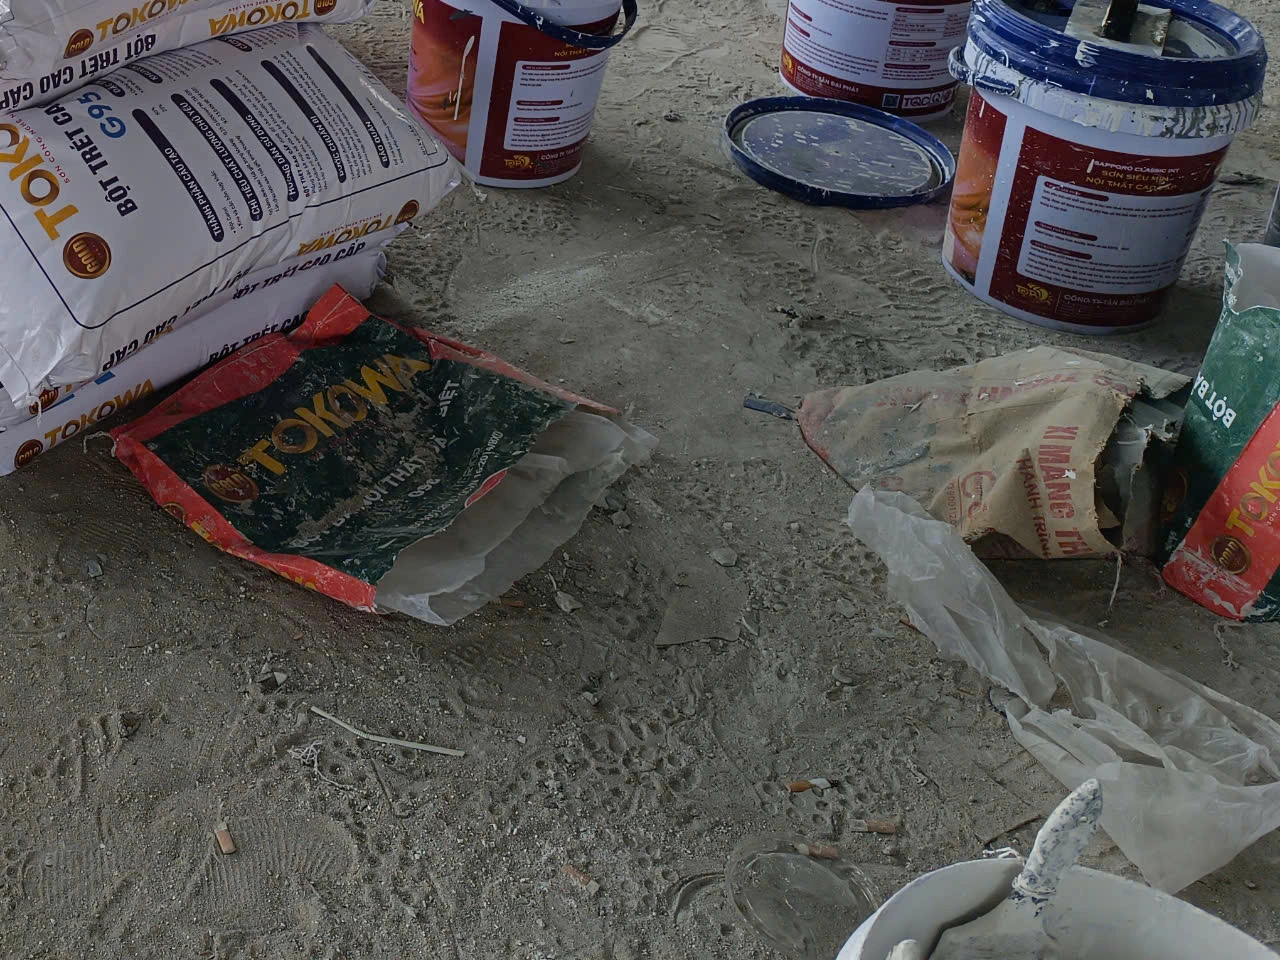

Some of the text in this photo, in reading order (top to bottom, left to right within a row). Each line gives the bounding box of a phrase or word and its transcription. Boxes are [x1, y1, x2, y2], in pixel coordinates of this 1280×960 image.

[124, 33, 156, 60] BỘT
[79, 47, 120, 79] TRÉT
[39, 66, 74, 93] CAO
[76, 91, 126, 139] G95
[246, 113, 265, 136] DỤNG
[260, 134, 272, 148] SỬ
[269, 145, 284, 164] DẪN
[64, 127, 138, 217] BỘT TRÉT
[180, 100, 262, 215] CHỈ TIÊU CHẤT LƯỢNG CHỦ YẾU
[1095, 160, 1133, 171] SAPPORO
[164, 146, 224, 235] THÀNH PHẦN CẤU TẠO
[1086, 177, 1134, 189] NỘI THẤT
[1102, 170, 1124, 179] SƠN
[297, 214, 393, 257] TOKOWA
[332, 239, 366, 262] CẤP
[73, 240, 101, 273] GOLD
[1064, 295, 1091, 303] CÔNG
[44, 379, 153, 448] TOKOWA
[236, 354, 432, 476] TOKOWA
[1205, 391, 1237, 429] BỘT
[1043, 425, 1079, 440] XI
[383, 454, 426, 488] THẤT
[1226, 442, 1280, 537] TOKO
